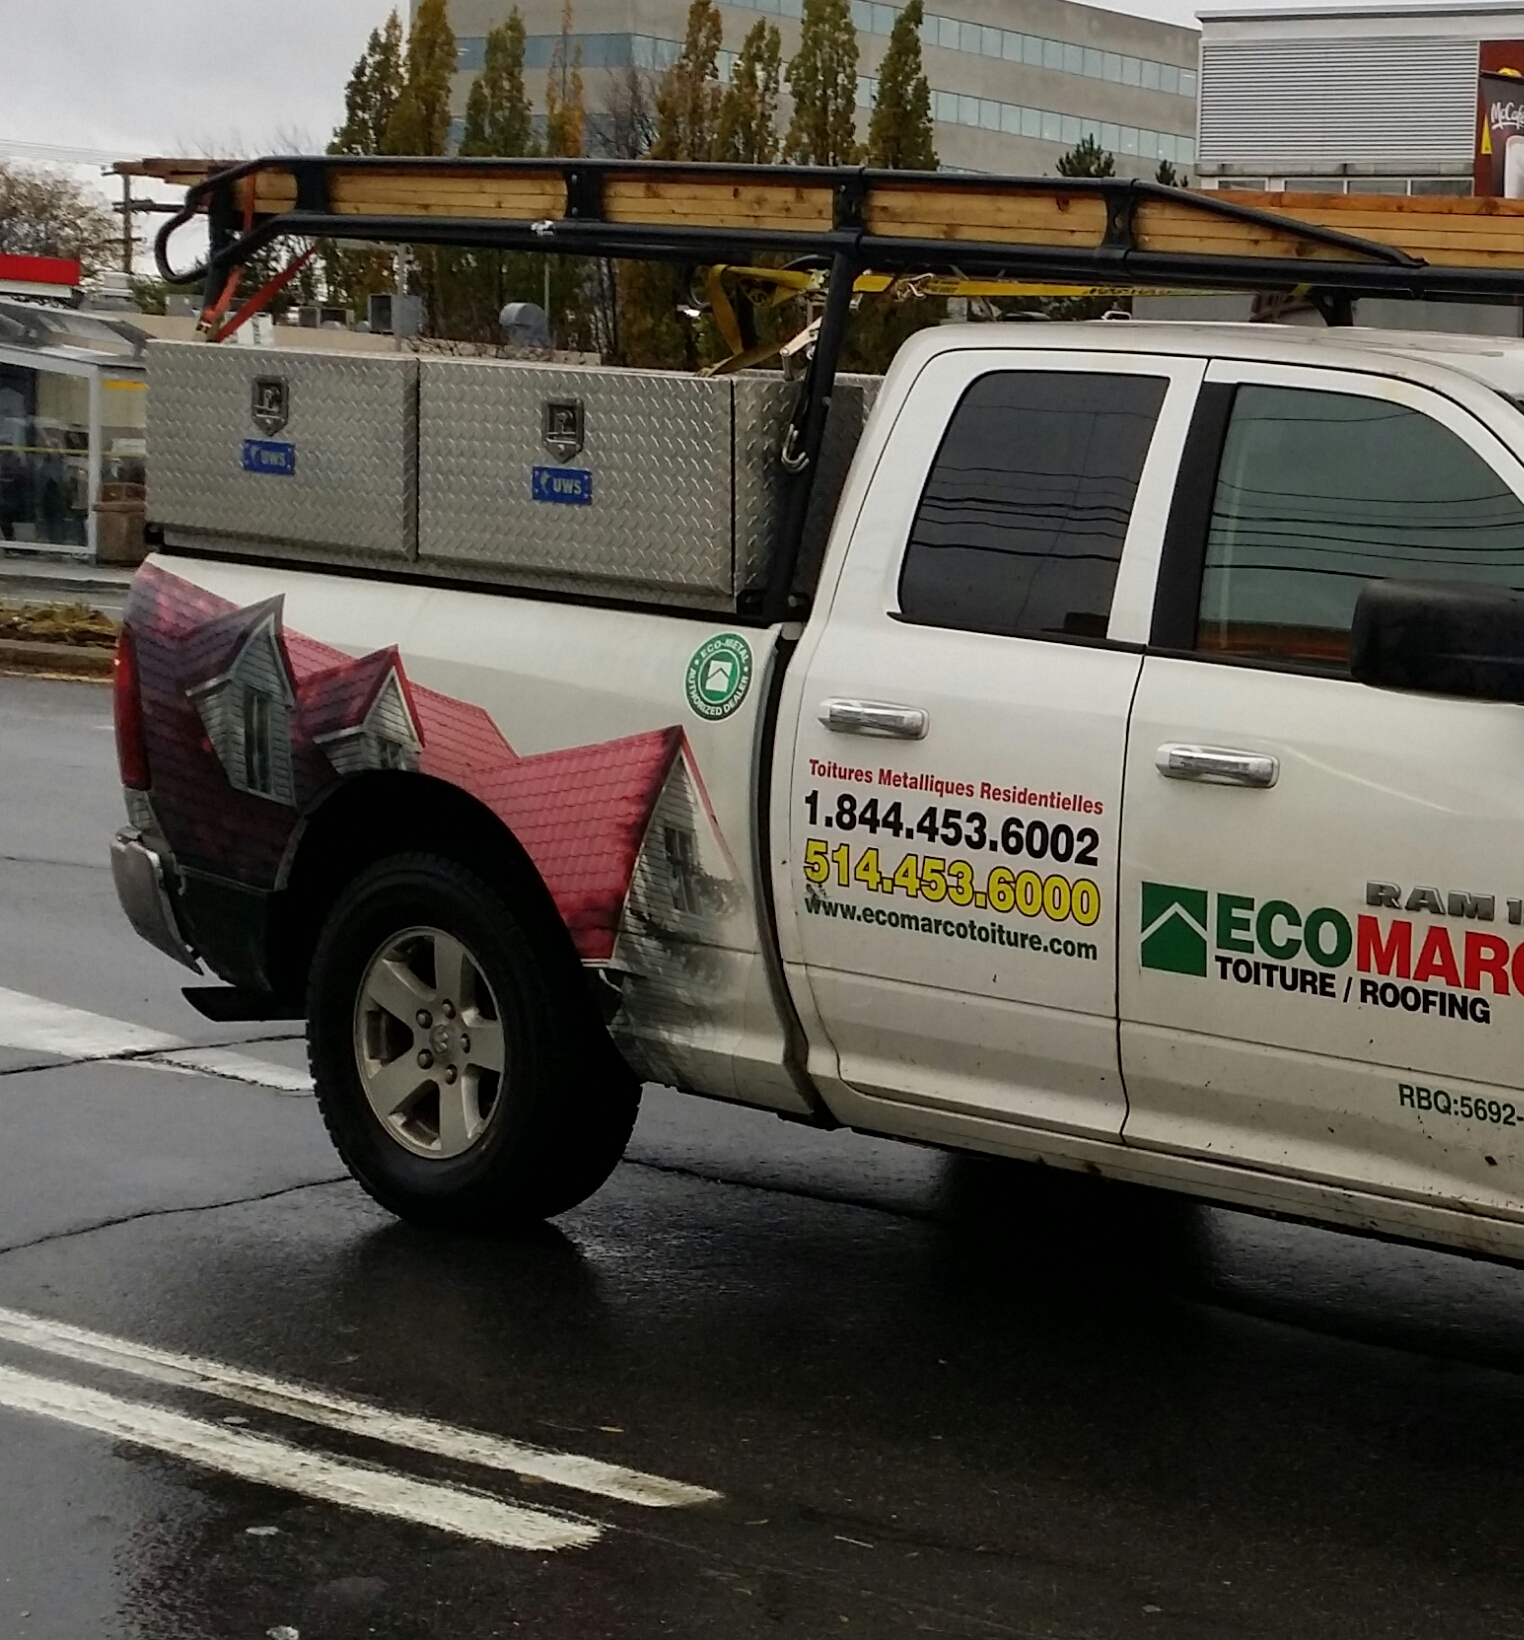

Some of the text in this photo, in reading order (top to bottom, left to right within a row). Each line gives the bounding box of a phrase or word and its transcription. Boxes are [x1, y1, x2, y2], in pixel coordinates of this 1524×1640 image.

[552, 476, 583, 495] UWS
[700, 638, 750, 664] ECO-METAL
[688, 667, 749, 716] AUTHORIZED DEALER
[809, 759, 1104, 815] Toitures Metalliques Residentielles
[805, 790, 1100, 866] 1.844.453.6002
[803, 838, 1101, 926] 514.453.6000
[1365, 880, 1496, 922] RAM
[804, 897, 1098, 960] www.ecomarcotoiture.com
[1214, 955, 1336, 998] TOITURE
[1360, 980, 1492, 1025] ROOFING
